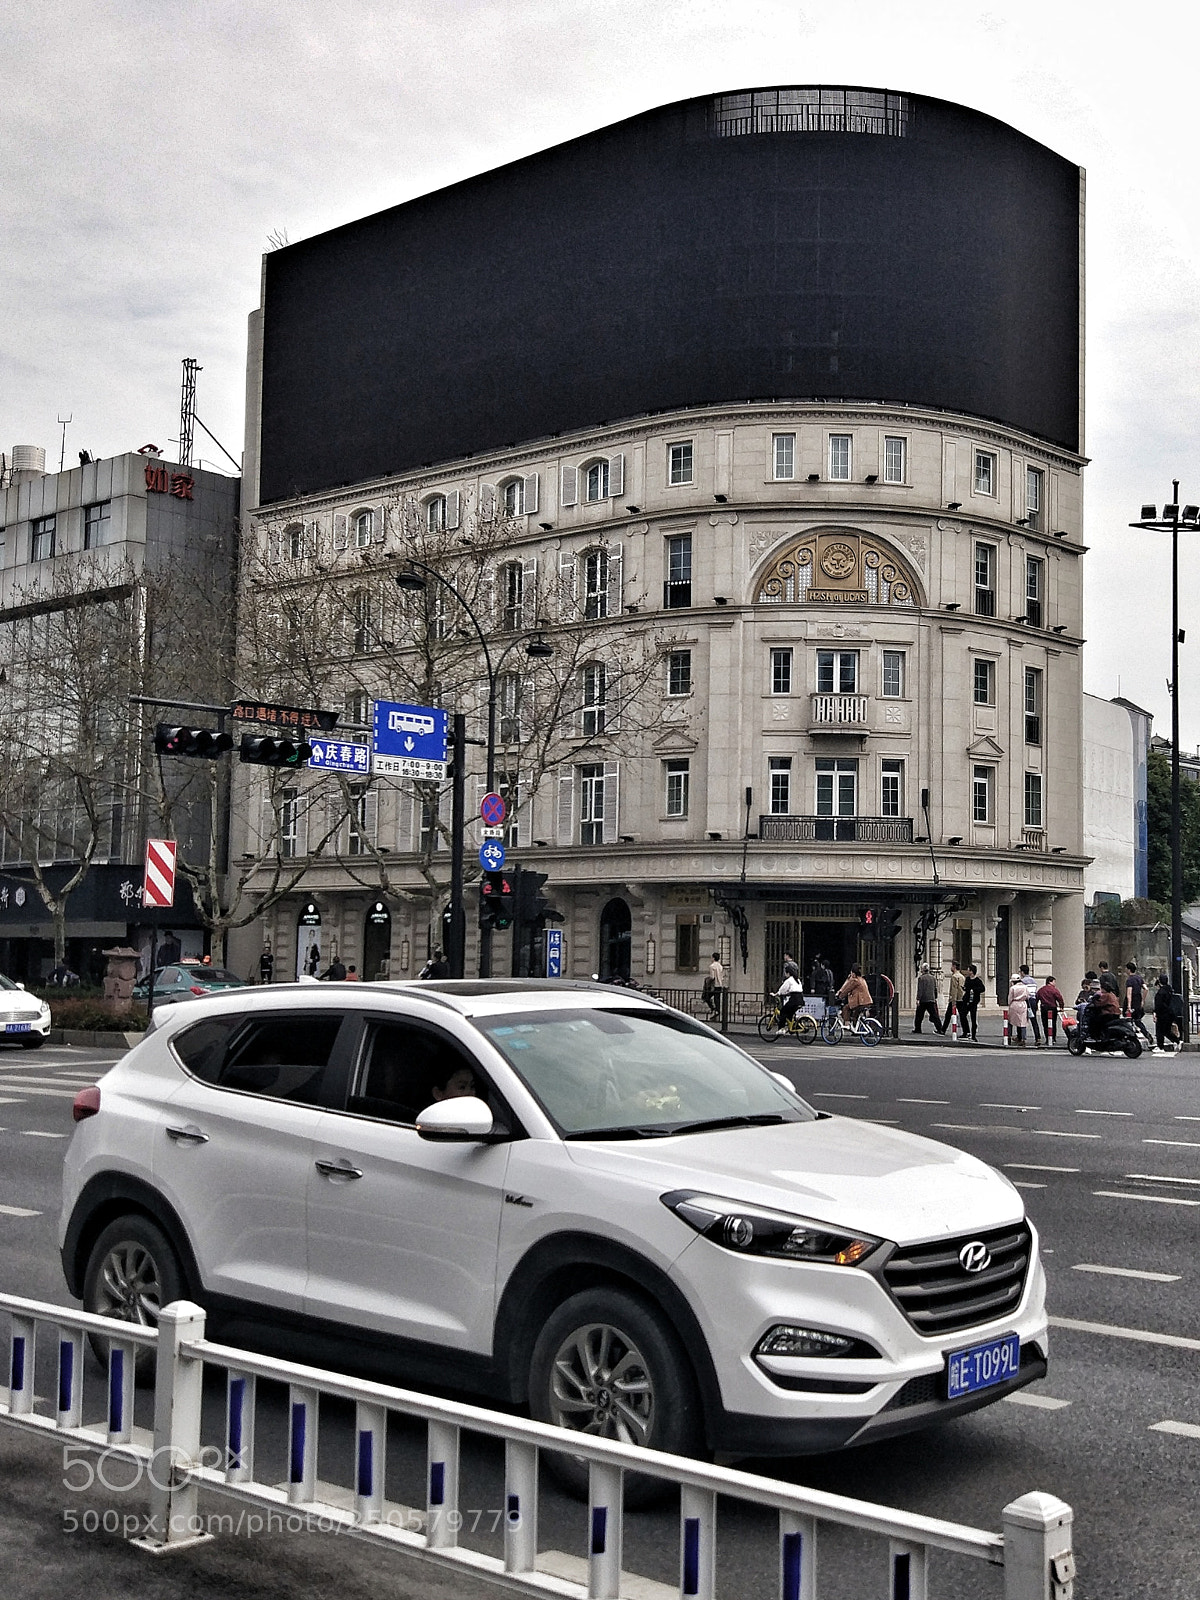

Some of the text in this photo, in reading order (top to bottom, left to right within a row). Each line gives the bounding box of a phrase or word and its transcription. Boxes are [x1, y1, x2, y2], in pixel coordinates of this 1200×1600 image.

[144, 464, 195, 501] 如家
[325, 743, 367, 764] 庆春路
[376, 760, 400, 772] 工作日
